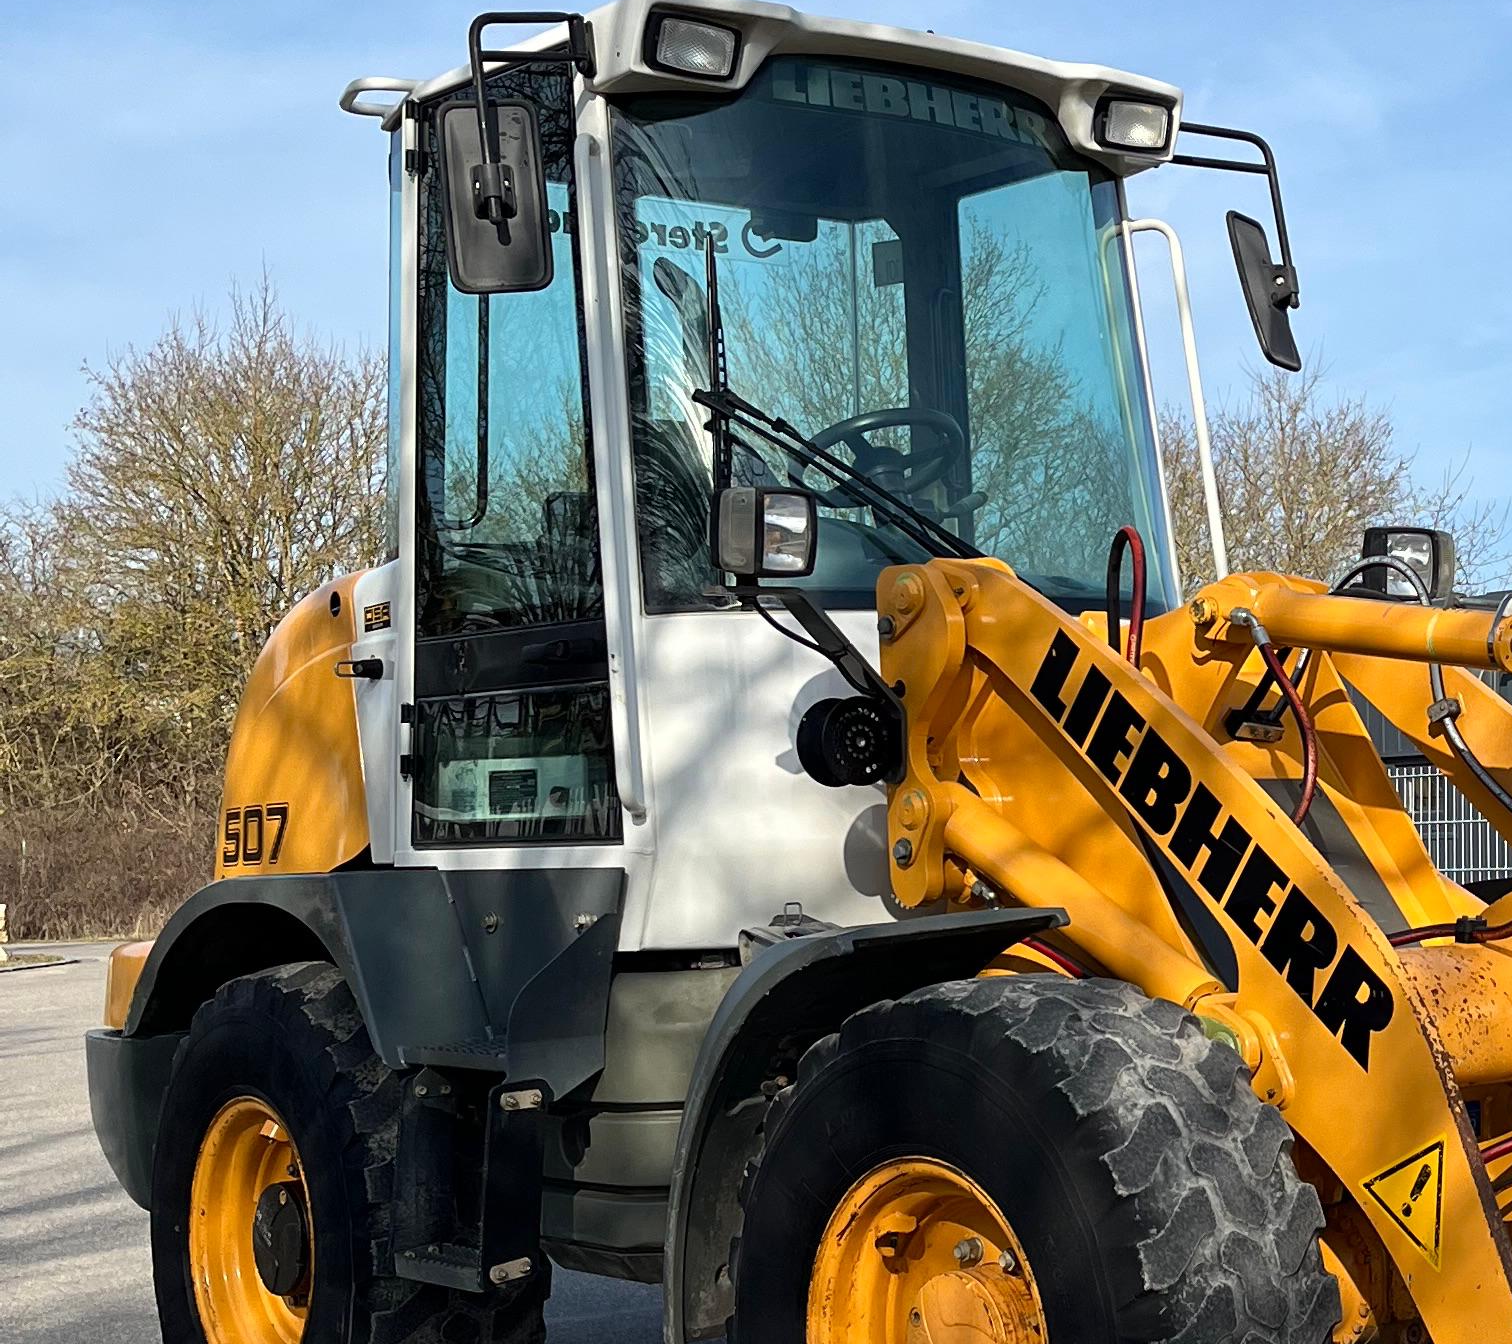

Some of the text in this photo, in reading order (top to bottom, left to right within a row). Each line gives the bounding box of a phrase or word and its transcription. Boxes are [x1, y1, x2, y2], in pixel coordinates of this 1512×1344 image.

[773, 61, 1047, 149] LIEBHERR
[223, 802, 289, 867] 507
[1029, 627, 1395, 1073] LIEBHERR
